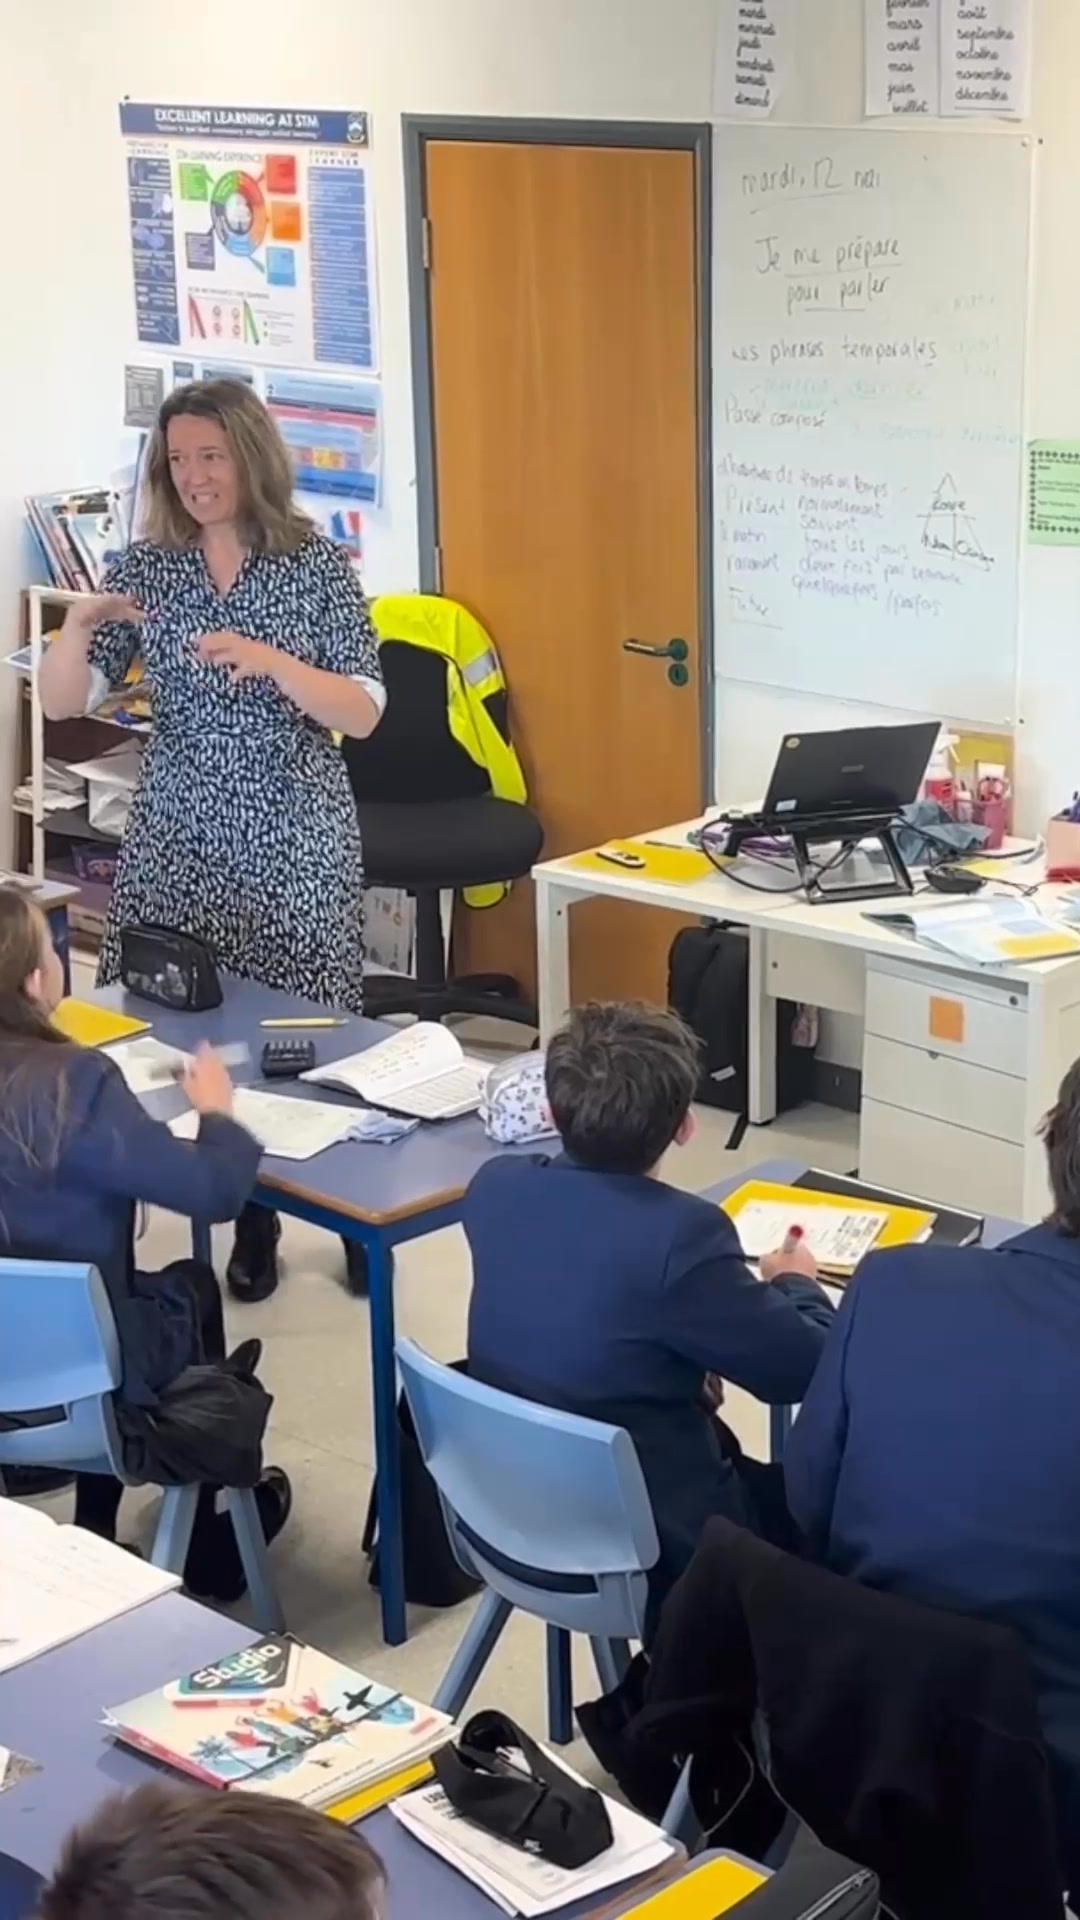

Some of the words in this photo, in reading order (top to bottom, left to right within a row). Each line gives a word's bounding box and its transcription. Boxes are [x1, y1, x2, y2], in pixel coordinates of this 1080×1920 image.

[957, 6, 987, 20] août
[887, 19, 923, 30] mars
[887, 37, 921, 52] avril
[957, 26, 1015, 51] septembre
[956, 46, 999, 60] octobre
[888, 62, 914, 72] mai
[956, 67, 1012, 81] novembre
[887, 80, 915, 101] juin
[955, 86, 1008, 101] décembre
[153, 107, 211, 125] EXCELLENT
[212, 111, 275, 127] LEARNING
[278, 113, 293, 127] AT
[295, 114, 319, 129] STM
[814, 156, 843, 189] 12
[754, 236, 781, 274] Je
[793, 247, 821, 264] me
[836, 235, 899, 272] prépare
[786, 285, 820, 316] pour
[840, 272, 890, 308] parler
[770, 339, 824, 366] phrases
[841, 335, 937, 365] temporales
[192, 1644, 282, 1689] Studio
